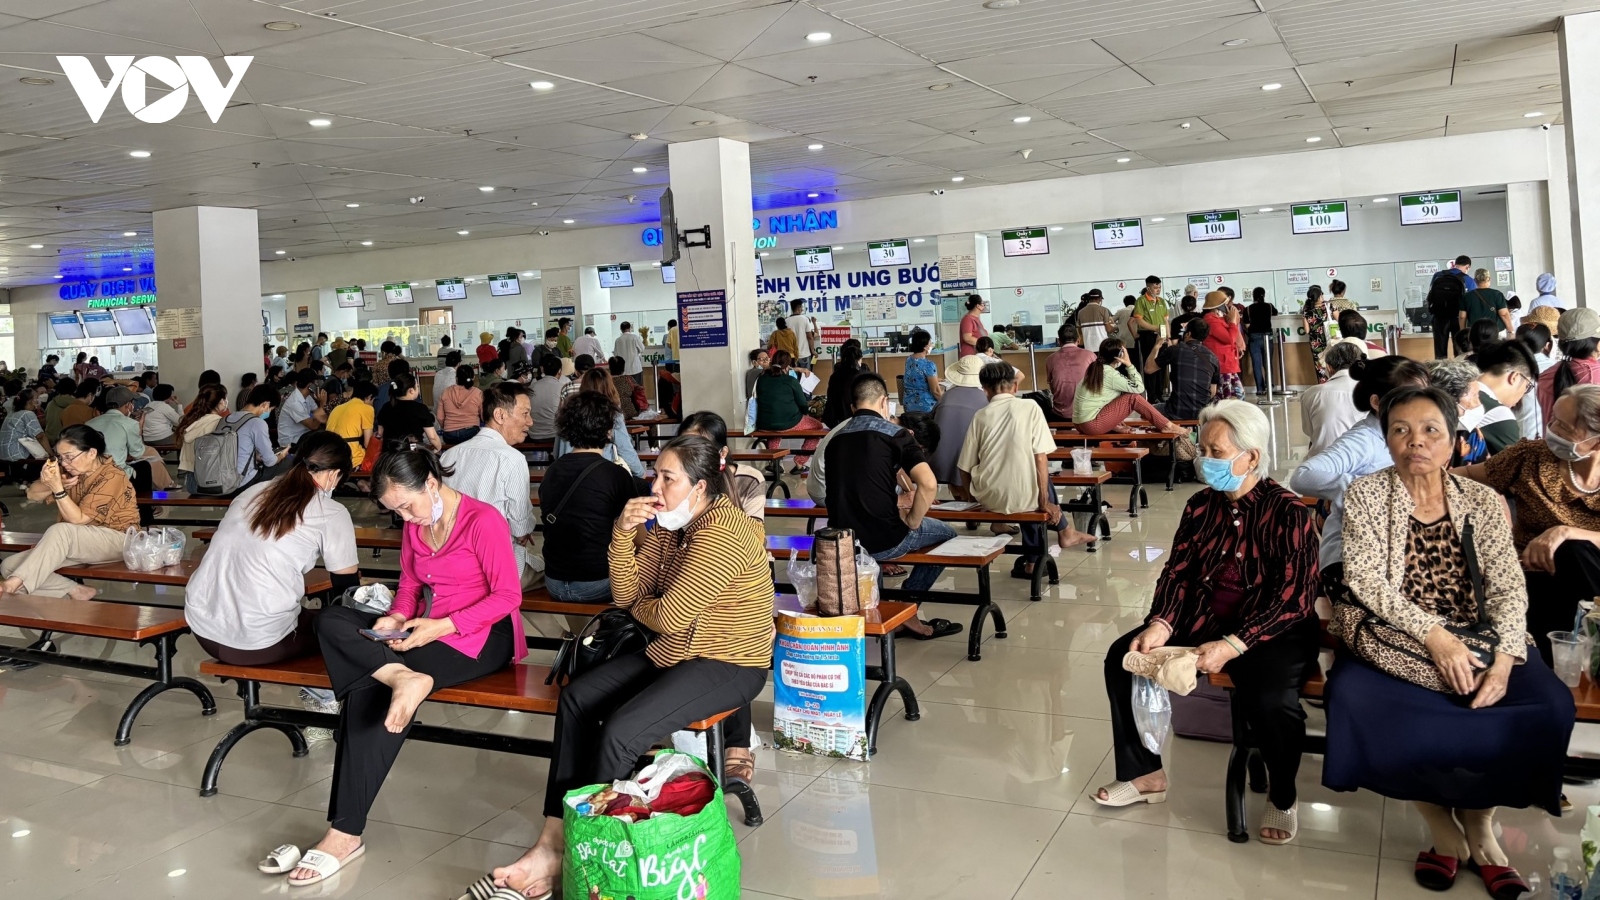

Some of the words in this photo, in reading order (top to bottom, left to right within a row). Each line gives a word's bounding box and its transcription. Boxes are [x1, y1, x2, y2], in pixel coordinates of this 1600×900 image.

[1421, 205, 1439, 217] 90
[769, 208, 837, 234] NHẬN
[1309, 214, 1331, 226] 100
[1204, 223, 1225, 234] 100
[1110, 229, 1124, 240] 33
[1018, 240, 1032, 250] 35
[883, 249, 895, 258] 30
[808, 255, 819, 264] 45
[610, 272, 620, 280] 73
[796, 270, 841, 293] VIỆN
[847, 269, 891, 288] UNG
[60, 280, 98, 300] QUẦY
[102, 280, 135, 297] DỊCH
[446, 285, 455, 293] 43
[500, 281, 509, 289] 40
[87, 296, 128, 308] FINANCIAL
[346, 293, 354, 301] 46
